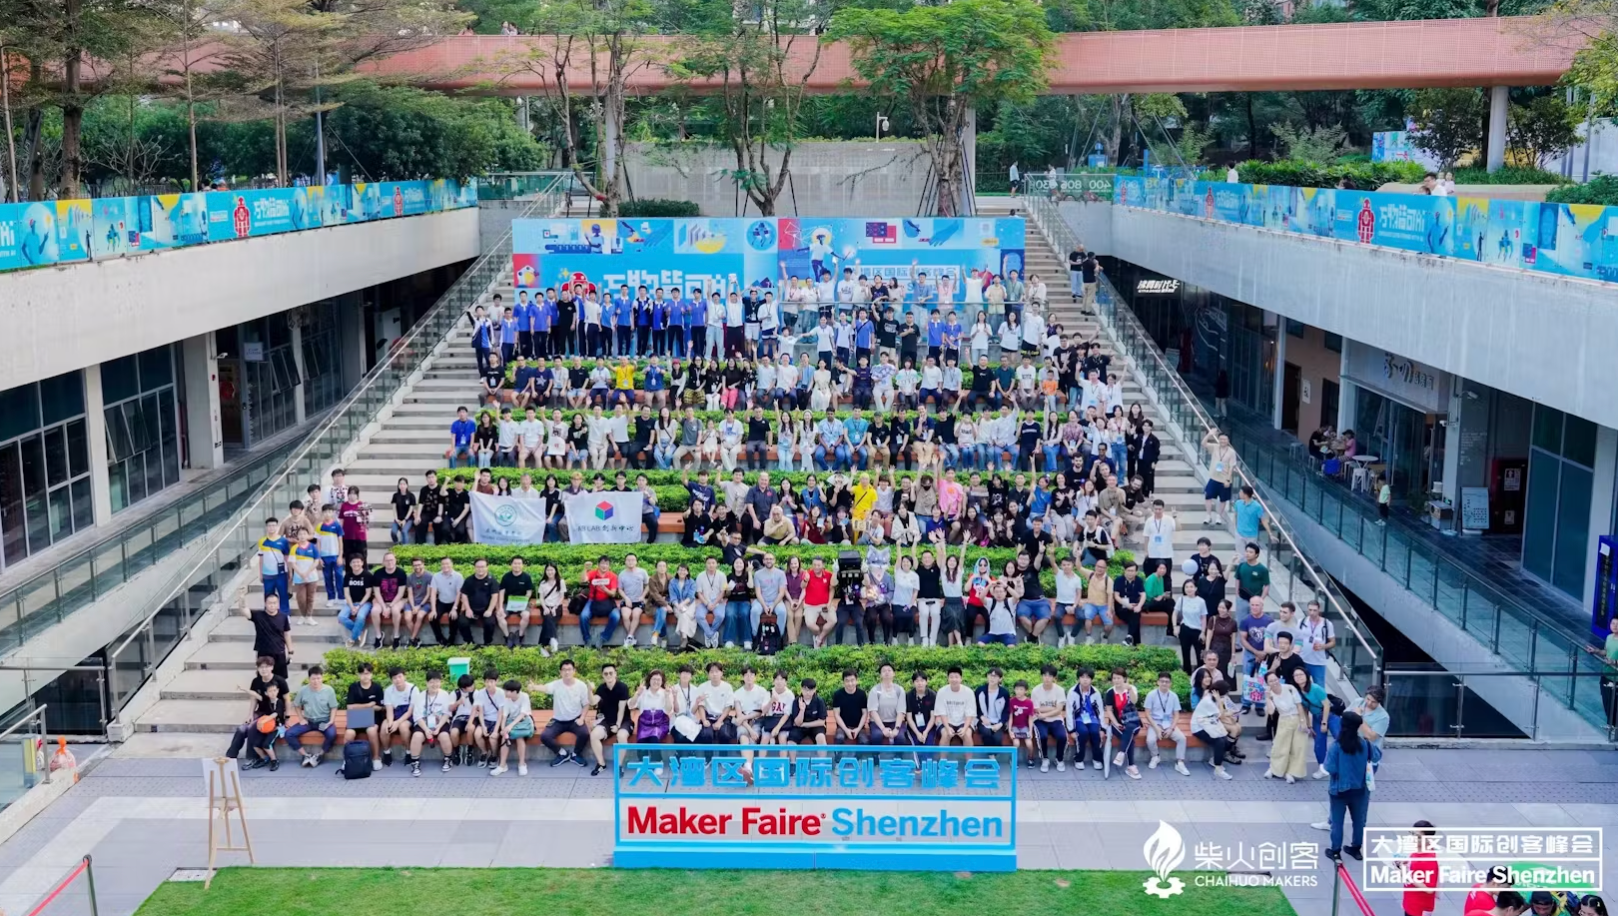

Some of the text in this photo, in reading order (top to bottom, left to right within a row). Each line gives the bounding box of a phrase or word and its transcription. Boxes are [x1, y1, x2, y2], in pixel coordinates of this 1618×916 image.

[627, 756, 1000, 788] 大湾区国际创客峰会
[628, 806, 732, 834] Maker
[832, 808, 1002, 837] Shenzhen
